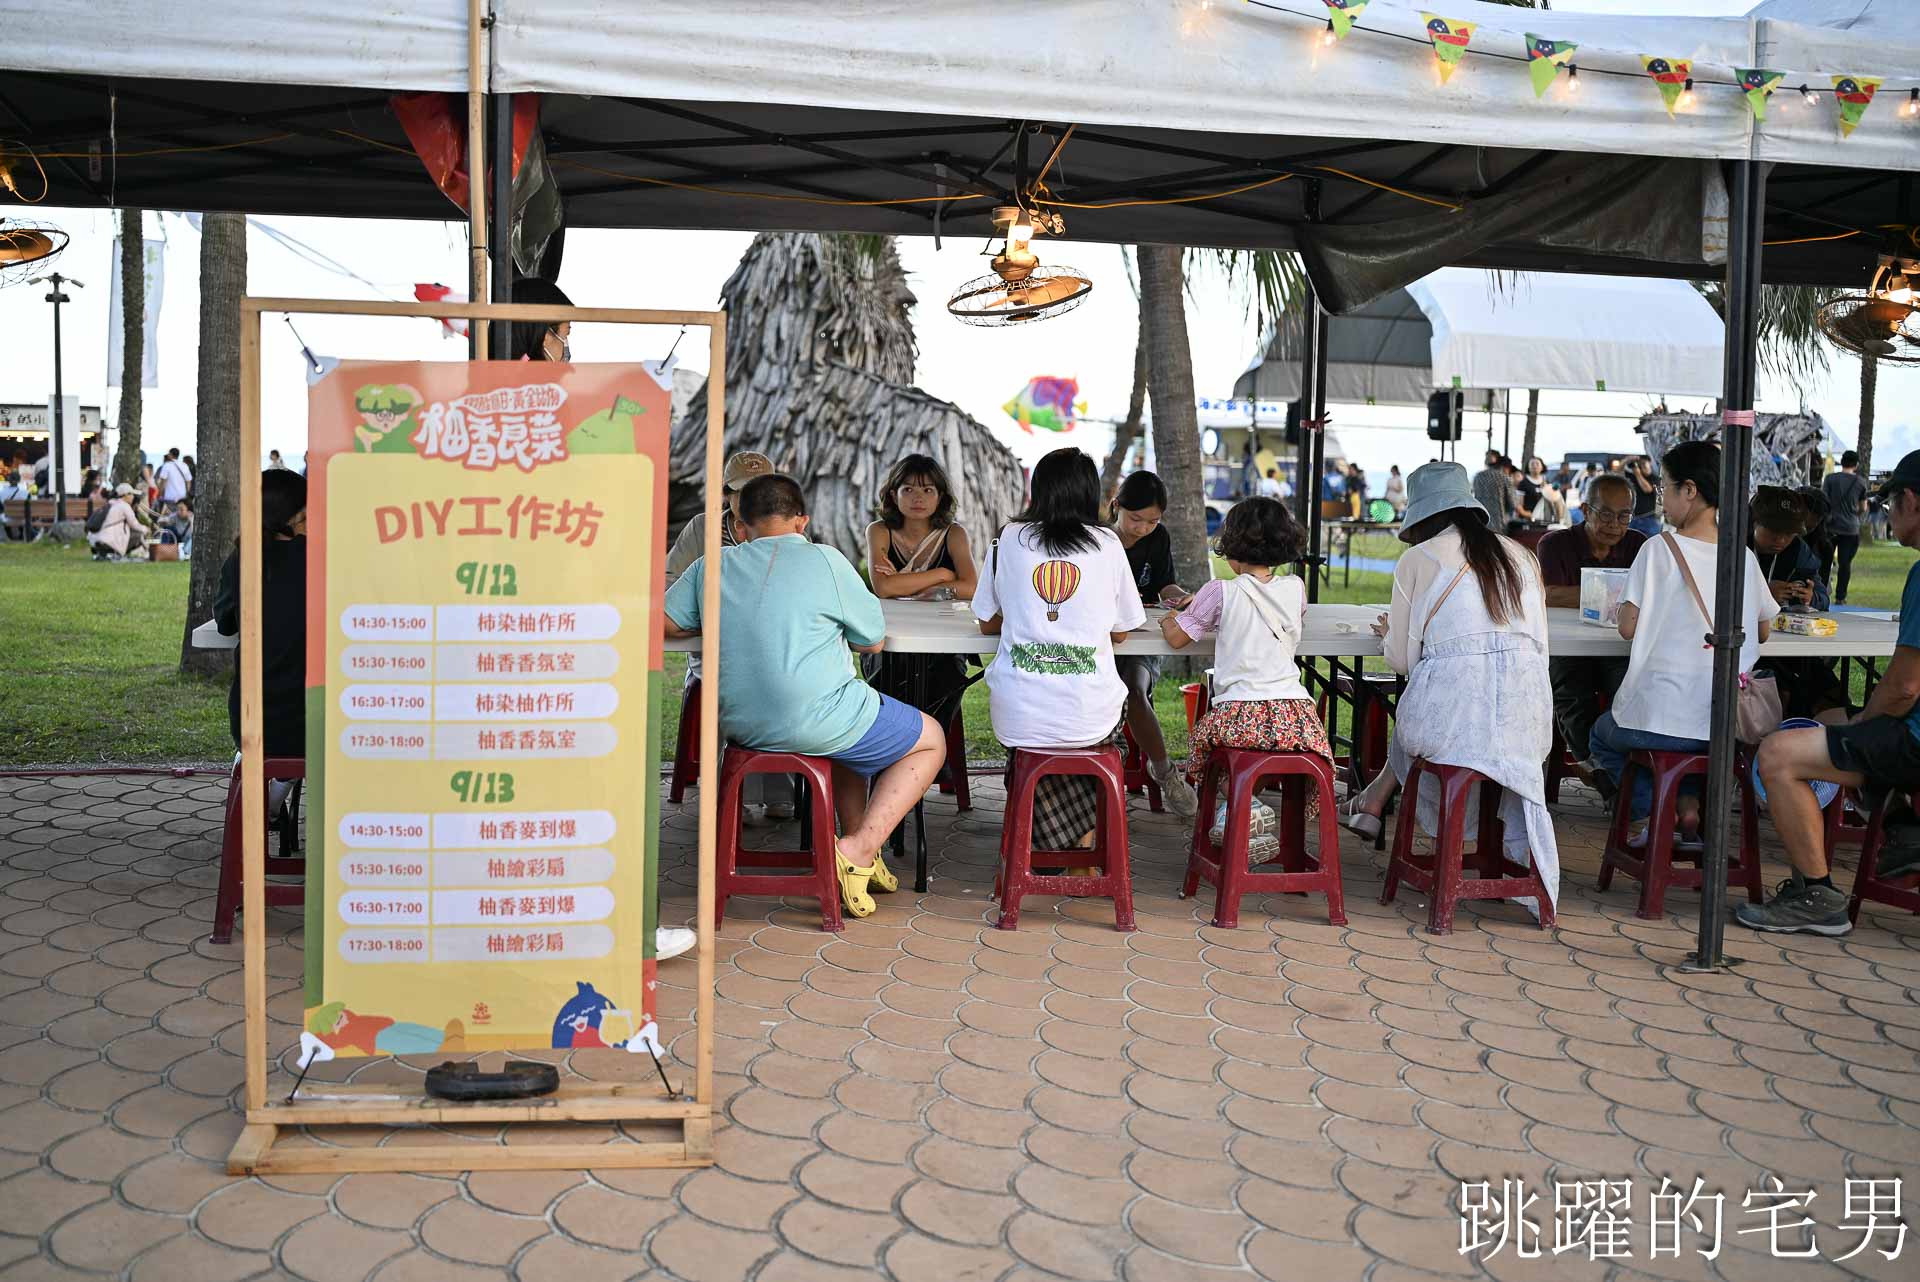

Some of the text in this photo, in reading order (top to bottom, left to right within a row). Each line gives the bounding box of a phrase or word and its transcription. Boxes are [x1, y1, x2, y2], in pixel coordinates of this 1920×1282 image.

[374, 494, 604, 547] DIY工作坊
[455, 561, 518, 596] 9/12
[351, 612, 577, 633] 14:30-15:00 柿染柚作所
[351, 651, 576, 673] 15:30-16:00 柚香香氛室
[350, 691, 575, 713] 16:30-17:00 柿染柚作所
[350, 729, 577, 751] 17:30-18:00 柚香香氛室
[450, 770, 515, 803] 9/13
[349, 818, 577, 840] 14:30-15:00 柚香麥到爆
[349, 856, 565, 879] 15:30-16:00 柚繪彩扇
[348, 895, 576, 917] 16:30-17:00 柚香麥到爆
[348, 932, 564, 954] 17:30-18:00 柚繪彩扇
